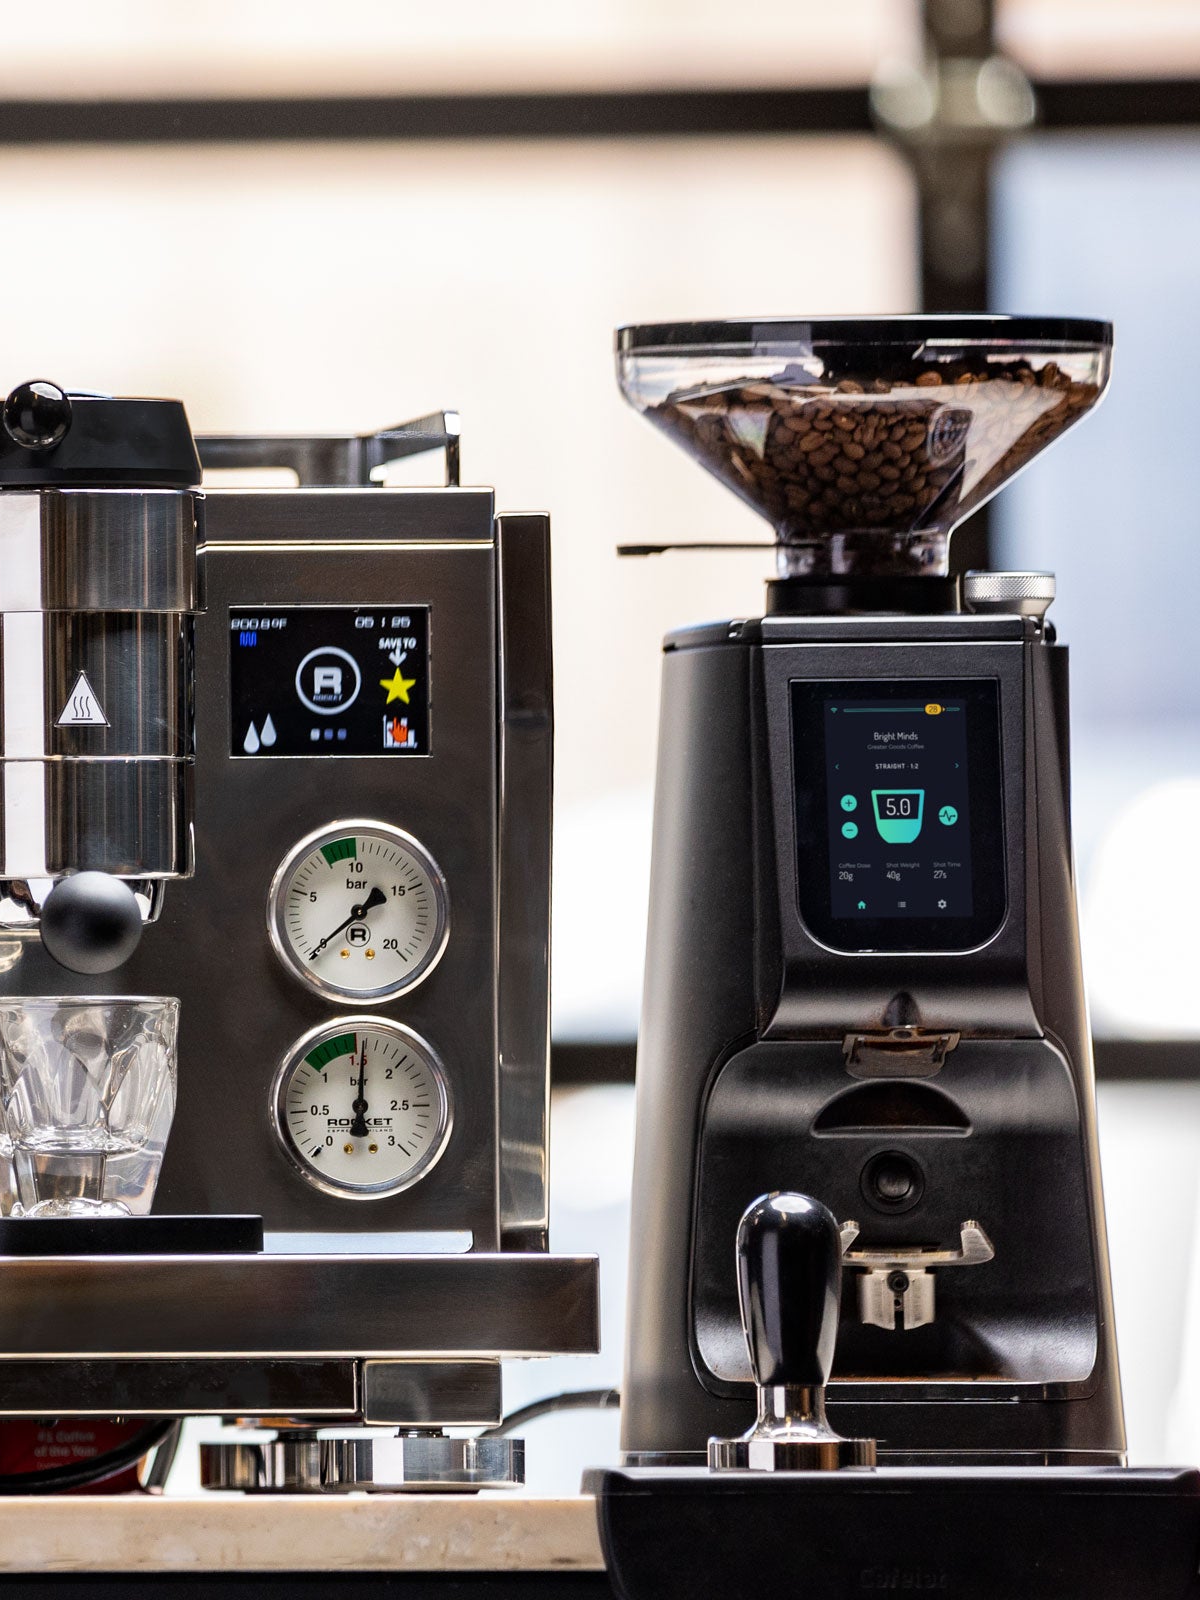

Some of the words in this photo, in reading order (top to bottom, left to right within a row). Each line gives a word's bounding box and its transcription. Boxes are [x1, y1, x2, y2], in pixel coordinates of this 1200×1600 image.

[378, 637, 402, 649] SAVE
[403, 637, 417, 649] TO
[873, 732, 896, 742] Bright
[897, 732, 918, 741] Minds
[886, 798, 911, 816] 5.0
[348, 862, 363, 873] 10
[838, 871, 854, 882] 20g
[886, 870, 901, 881] 40g
[933, 870, 947, 879] 27s
[346, 878, 368, 889] bar
[391, 885, 406, 896] 15
[309, 891, 317, 902] 5
[382, 939, 398, 950] 20
[322, 1072, 328, 1083] 1
[385, 1068, 393, 1079] 2
[310, 1105, 329, 1116] 0.5
[390, 1100, 409, 1111] 2.5
[325, 1135, 333, 1146] 0
[387, 1135, 395, 1146] 3
